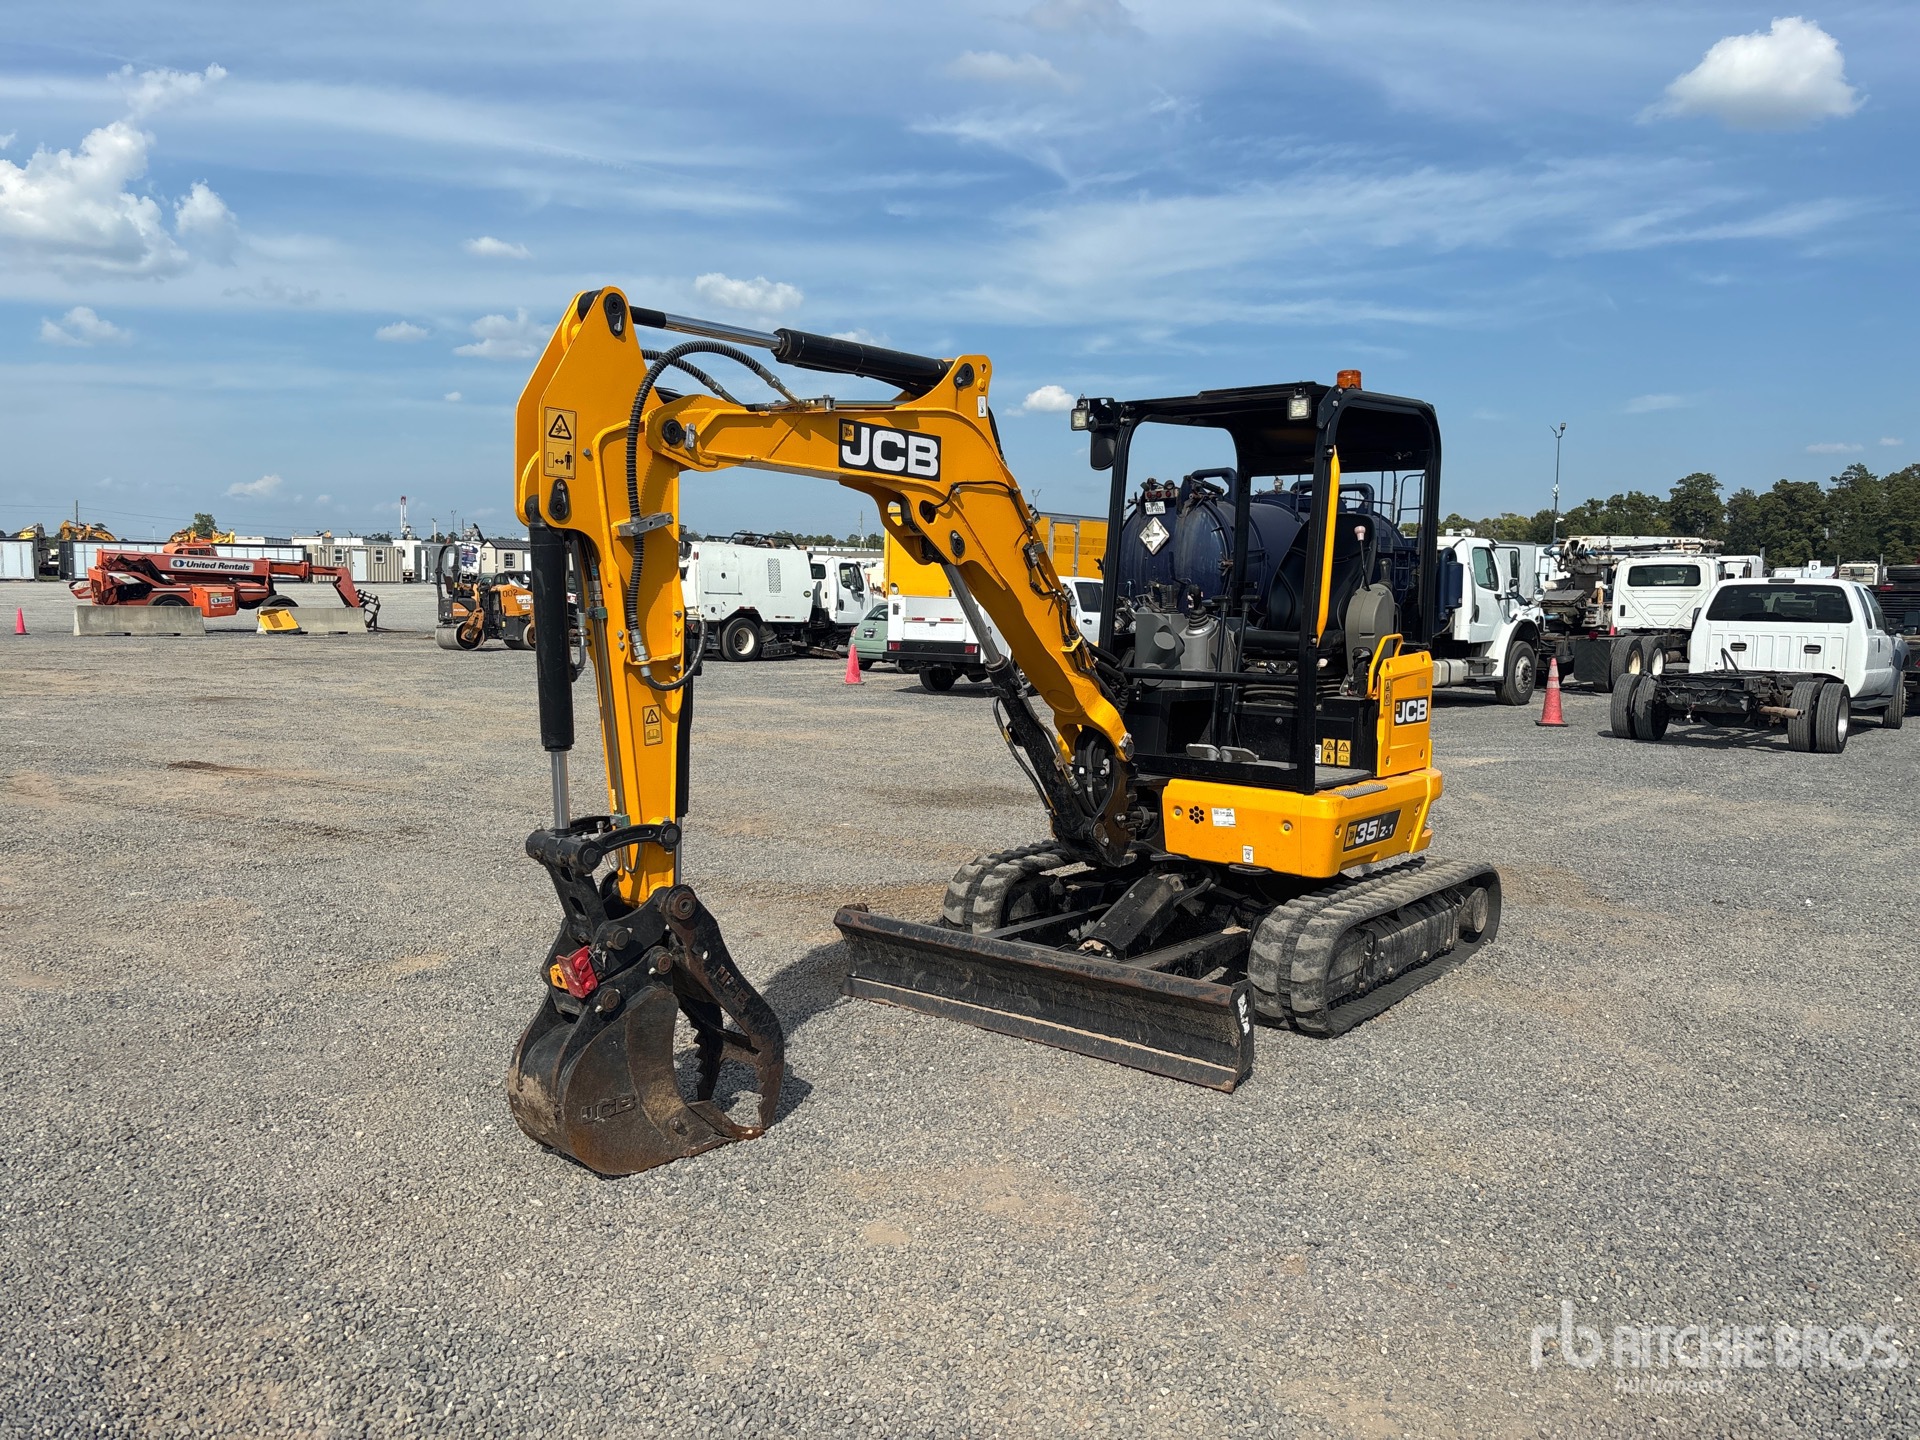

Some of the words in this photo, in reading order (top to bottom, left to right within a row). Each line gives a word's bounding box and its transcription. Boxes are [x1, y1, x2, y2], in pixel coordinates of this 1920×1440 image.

[842, 426, 938, 476] JCB
[186, 560, 216, 570] United
[217, 562, 250, 571] Rentals
[502, 588, 518, 598] 002
[1395, 699, 1428, 724] JCB
[580, 1093, 636, 1125] JCB
